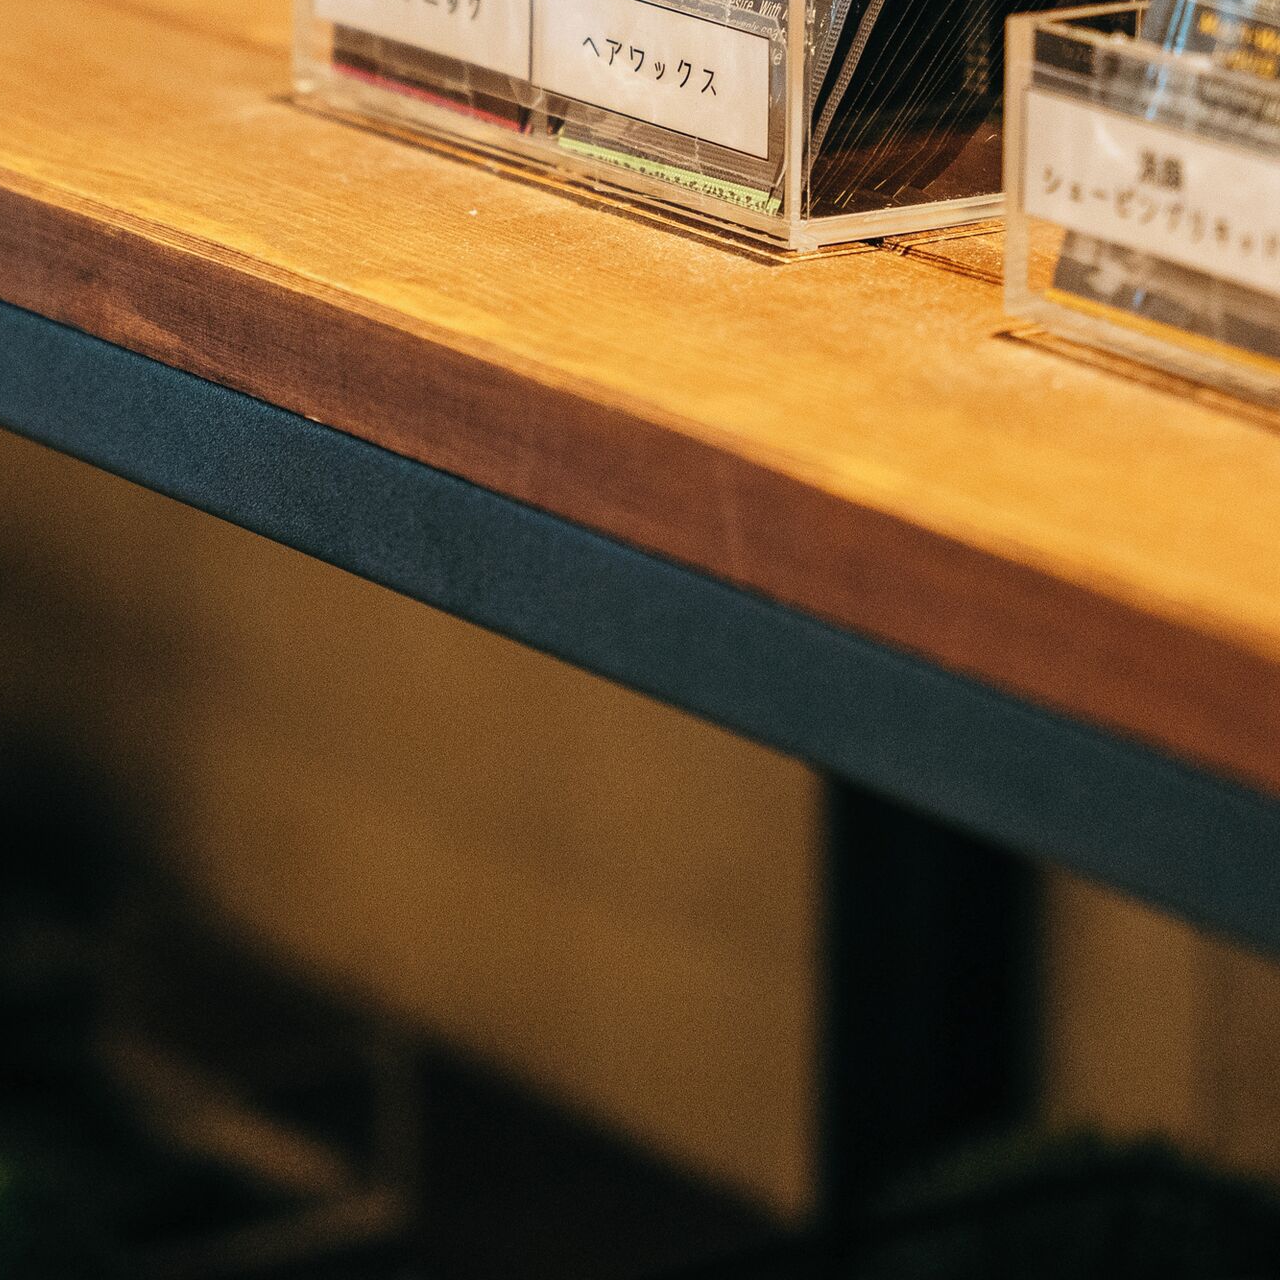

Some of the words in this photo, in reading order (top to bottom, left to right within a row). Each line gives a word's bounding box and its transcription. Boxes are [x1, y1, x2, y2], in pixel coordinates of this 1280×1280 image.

[581, 35, 719, 97] ヘアワックス
